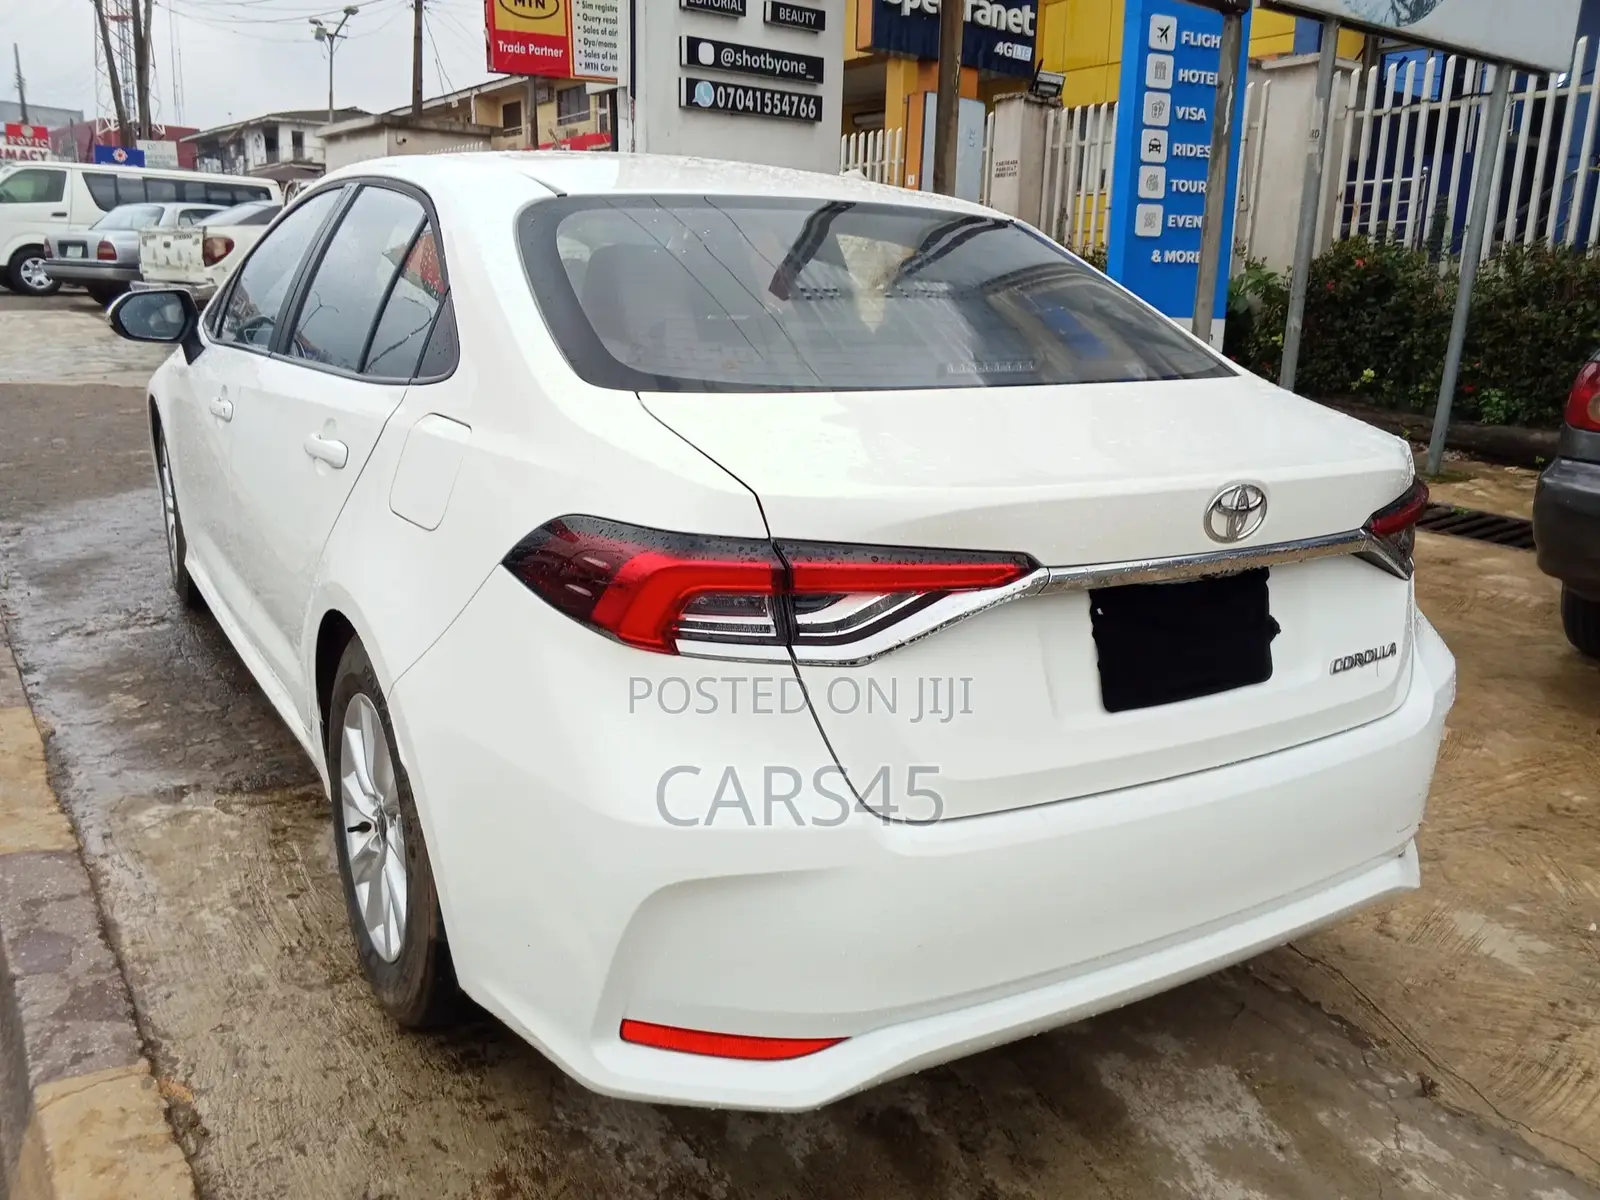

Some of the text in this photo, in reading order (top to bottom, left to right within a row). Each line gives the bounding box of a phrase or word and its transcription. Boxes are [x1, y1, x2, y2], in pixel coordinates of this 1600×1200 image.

[582, 0, 593, 10] Sim
[582, 12, 618, 26] Query resol
[779, 7, 816, 25] BEAUTY
[883, 0, 1035, 36] peranet
[583, 24, 600, 36] Sales
[601, 27, 607, 36] of
[1181, 31, 1222, 49] FLIGH
[498, 40, 564, 58] Trade Partner
[584, 49, 601, 60] Sales
[602, 52, 608, 61] of
[994, 41, 1013, 58] 4G
[584, 61, 599, 72] MTN
[720, 48, 815, 79] @shotbyone_
[716, 85, 817, 119] 07041554766
[1175, 105, 1207, 121] VISA
[1172, 143, 1212, 158] RIDES
[1170, 179, 1207, 193] TOUR
[1167, 214, 1204, 228] EVEN
[1151, 249, 1162, 263] &
[1329, 641, 1397, 676] COROLLA
